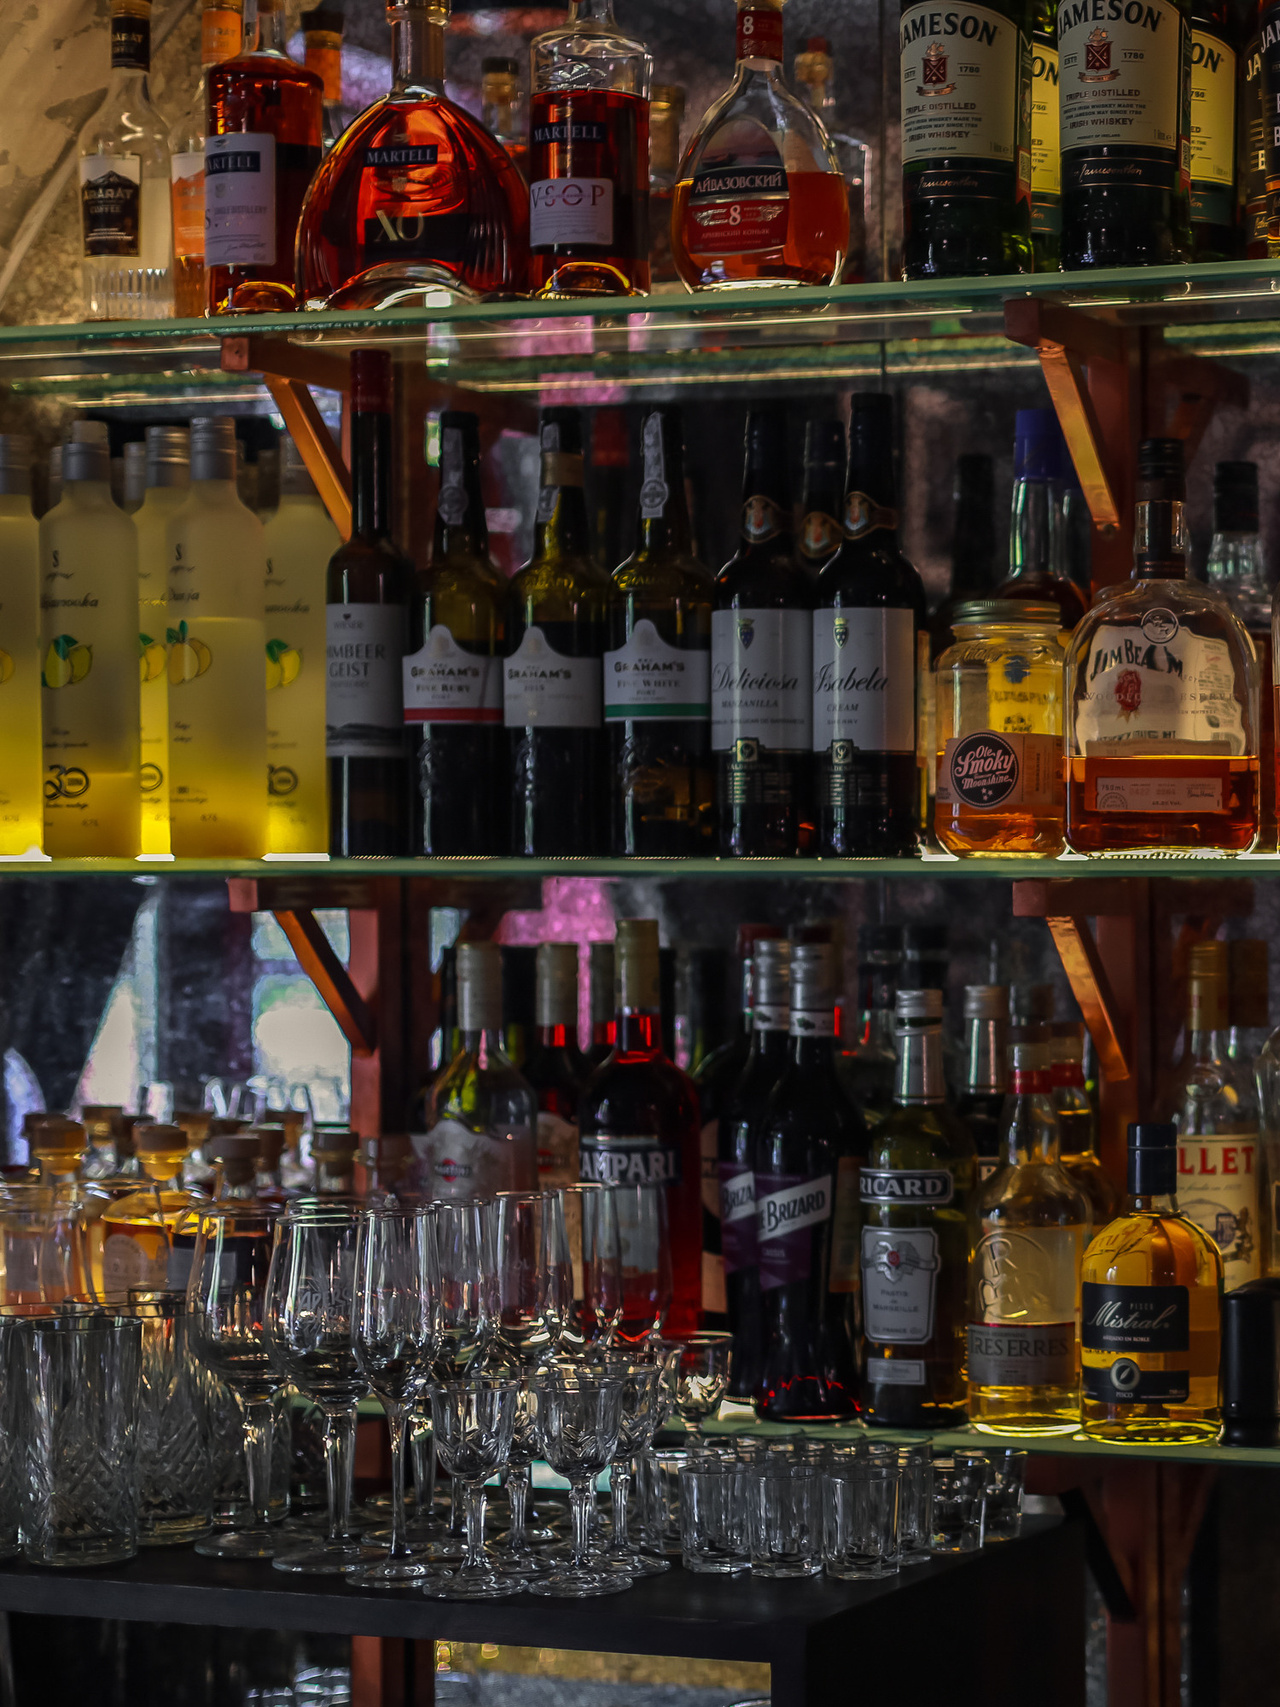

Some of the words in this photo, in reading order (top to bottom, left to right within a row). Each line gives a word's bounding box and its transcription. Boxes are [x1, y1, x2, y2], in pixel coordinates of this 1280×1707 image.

[743, 16, 755, 35] 8
[1058, 0, 1162, 41] JAMESON
[899, 12, 999, 47] JAMESON
[1123, 50, 1145, 60] 1780
[1066, 90, 1090, 102] TRIPLE
[1092, 89, 1141, 97] DISTILLED
[906, 104, 927, 115] TRIPLE
[929, 103, 977, 111] DISTILLED
[1069, 120, 1088, 129] IRISH
[1091, 117, 1134, 125] WHISKEY
[534, 125, 601, 142] MARTELL
[909, 132, 926, 142] IRISH
[928, 131, 970, 139] WHISKEY
[205, 156, 254, 171] ARTELL
[366, 148, 435, 164] MARTELL
[695, 172, 783, 194] АЙВАЗОВСКИЙ
[84, 188, 133, 201] ARARAT
[531, 184, 606, 209] VSOP
[729, 204, 741, 226] 8
[374, 212, 425, 242] XO
[326, 643, 385, 660] IMBEER
[329, 662, 370, 678] GEIST
[411, 666, 480, 679] GRAHAM'S
[614, 661, 685, 673] GRAHAM'S
[1090, 649, 1123, 681] JIM
[507, 669, 572, 680] GRAHAM'S
[712, 661, 799, 693] Deliciosa
[813, 661, 889, 693] Isabela
[827, 703, 859, 712] CREAM
[976, 745, 996, 758] Ole
[954, 753, 1014, 777] Smoky
[961, 774, 1013, 790] Moonshine
[579, 1150, 675, 1180] AMPARI
[1177, 1146, 1255, 1176] LLET
[860, 1175, 943, 1197] RICARD
[723, 1183, 754, 1217] BRIZA
[767, 1189, 826, 1233] BRIZARD
[872, 1304, 919, 1313] MARSEILLE
[1086, 1300, 1178, 1329] Mistral
[1129, 1303, 1154, 1311] PISCO
[969, 1337, 1003, 1357] TRES
[1007, 1339, 1068, 1357] ERRES
